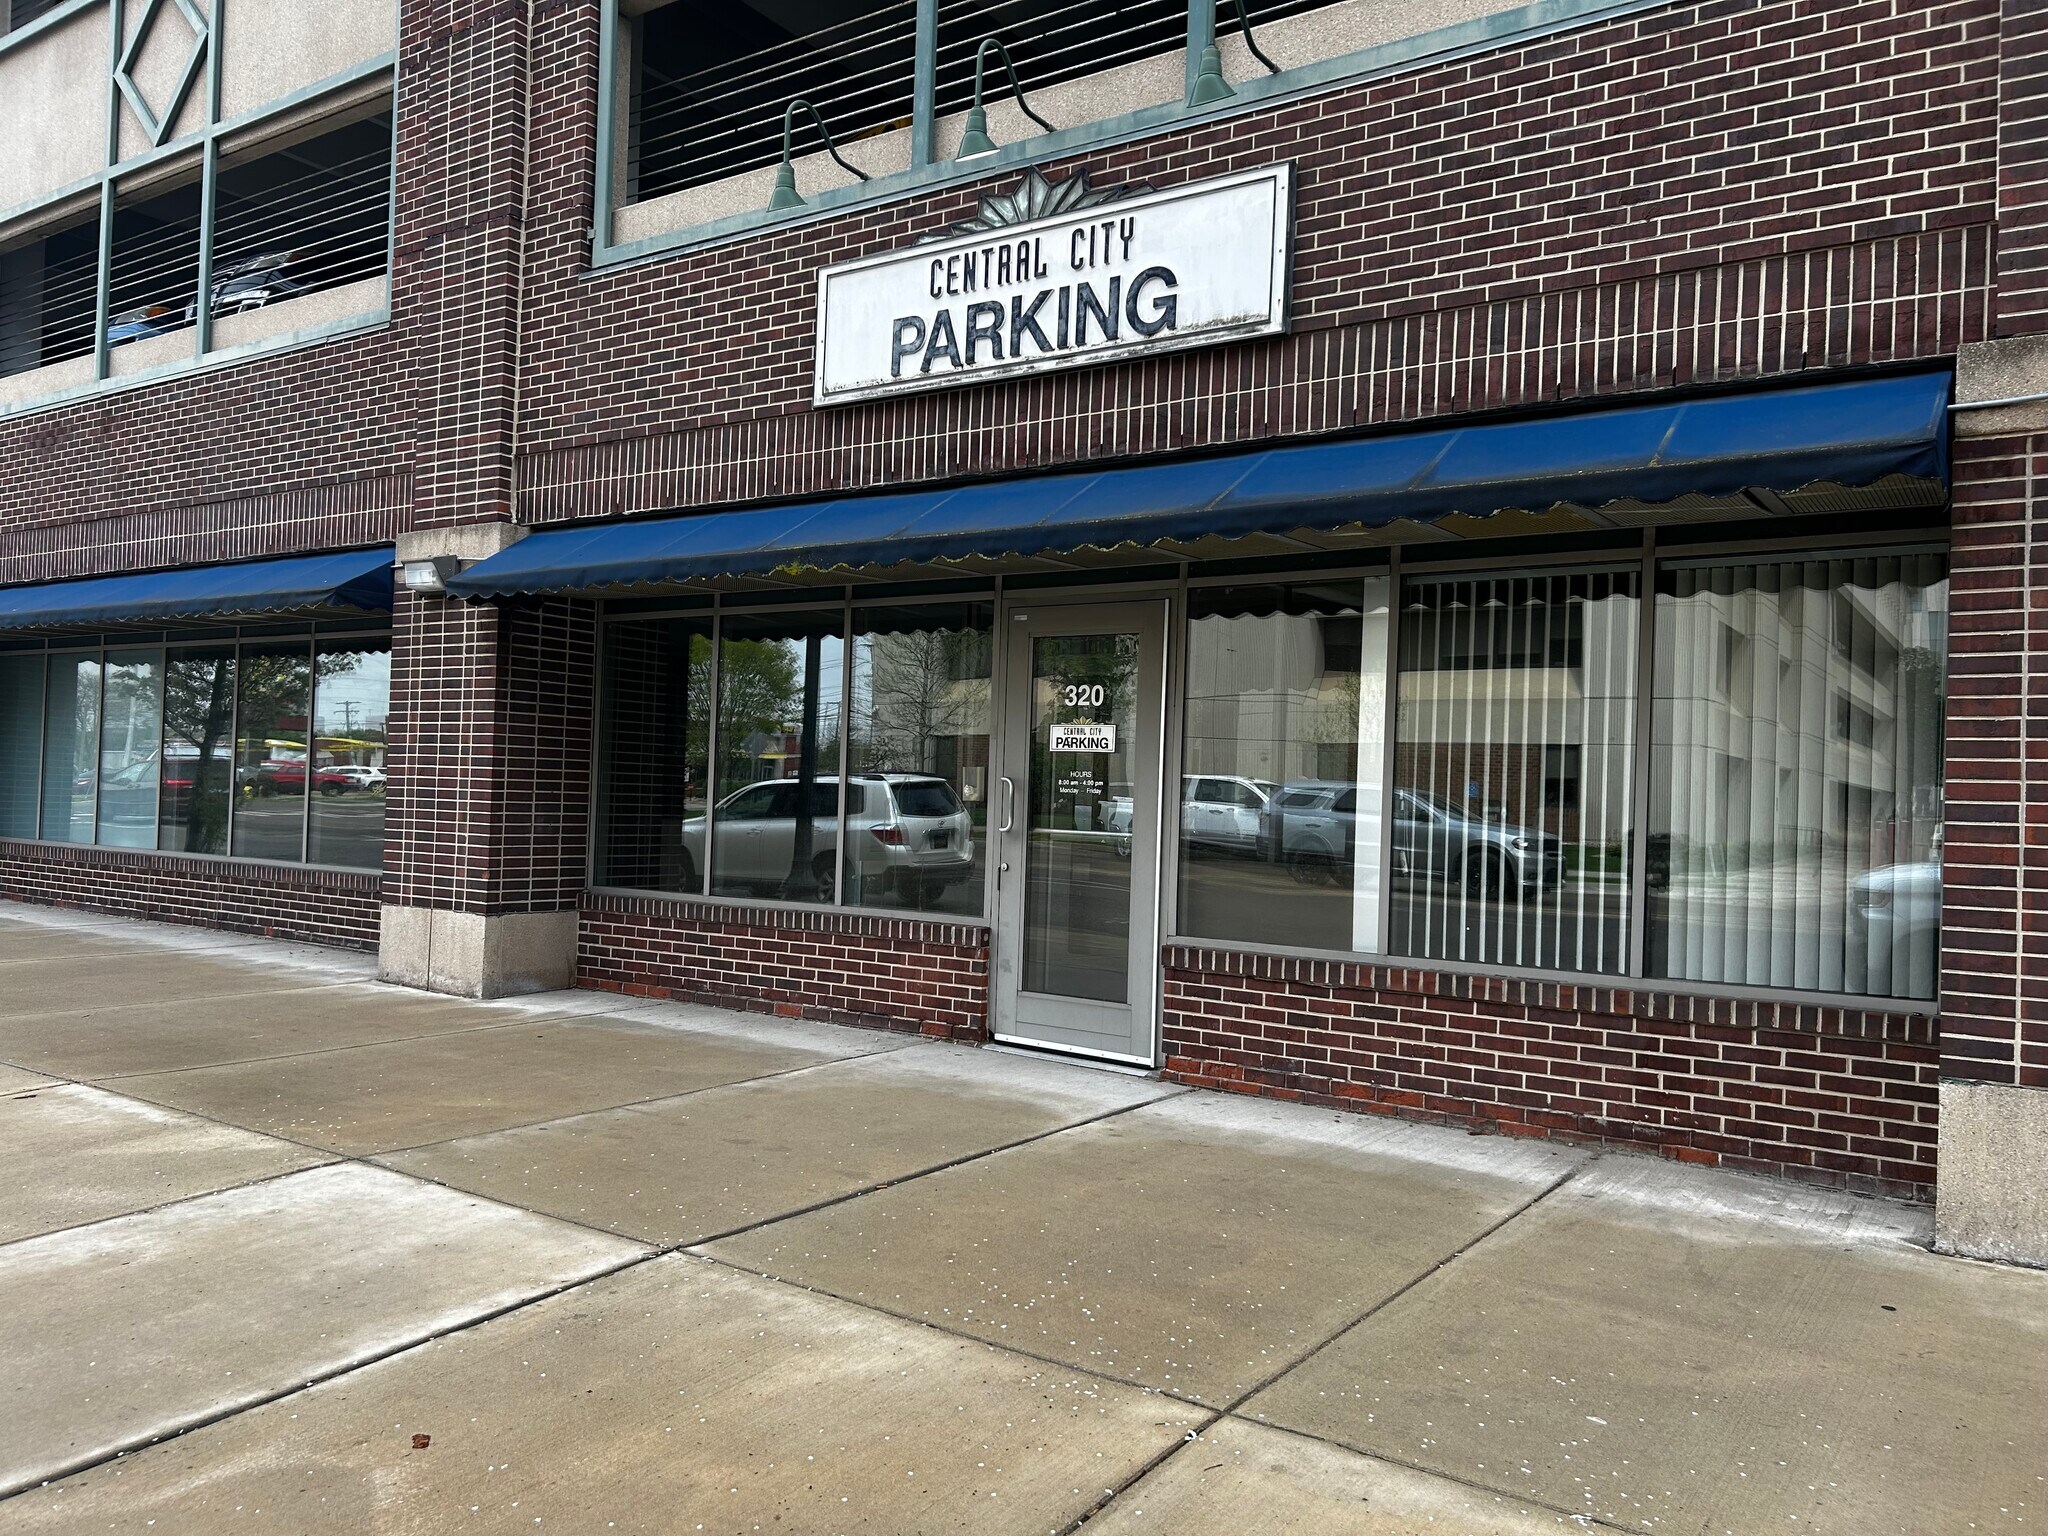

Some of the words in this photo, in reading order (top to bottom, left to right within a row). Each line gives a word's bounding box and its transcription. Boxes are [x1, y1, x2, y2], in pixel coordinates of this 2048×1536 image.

[929, 237, 1048, 299] CENTRAL
[1070, 216, 1135, 271] CITY
[890, 266, 1178, 378] PARKING
[1065, 684, 1104, 707] 320
[1063, 727, 1086, 736] CENTRAL
[1090, 727, 1102, 736] CITY
[1056, 736, 1108, 749] PARKING
[1070, 770, 1092, 778] HOURS
[1059, 787, 1079, 795] Monday
[1086, 787, 1102, 796] Friday
